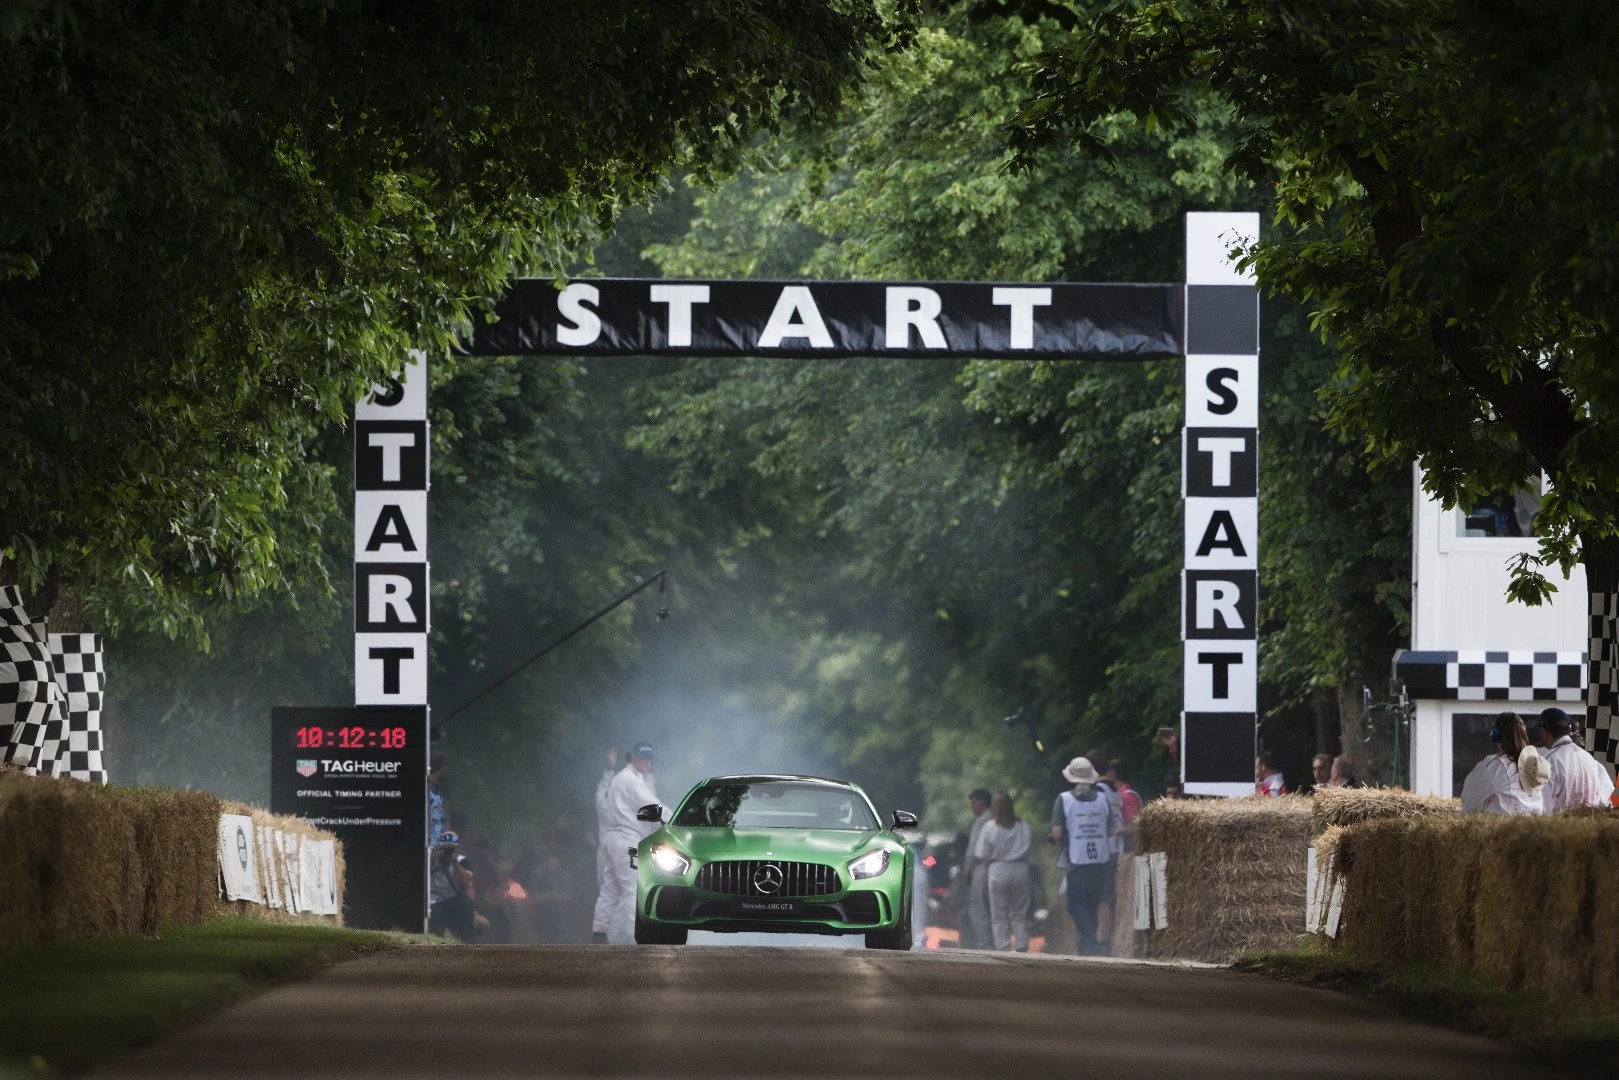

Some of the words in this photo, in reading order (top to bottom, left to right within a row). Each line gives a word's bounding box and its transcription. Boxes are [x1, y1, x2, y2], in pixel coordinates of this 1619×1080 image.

[556, 283, 1053, 349] START
[1195, 367, 1248, 700] START
[296, 727, 406, 748] 10:12:18
[365, 790, 402, 798] PARTNER
[1087, 842, 1098, 859] 65
